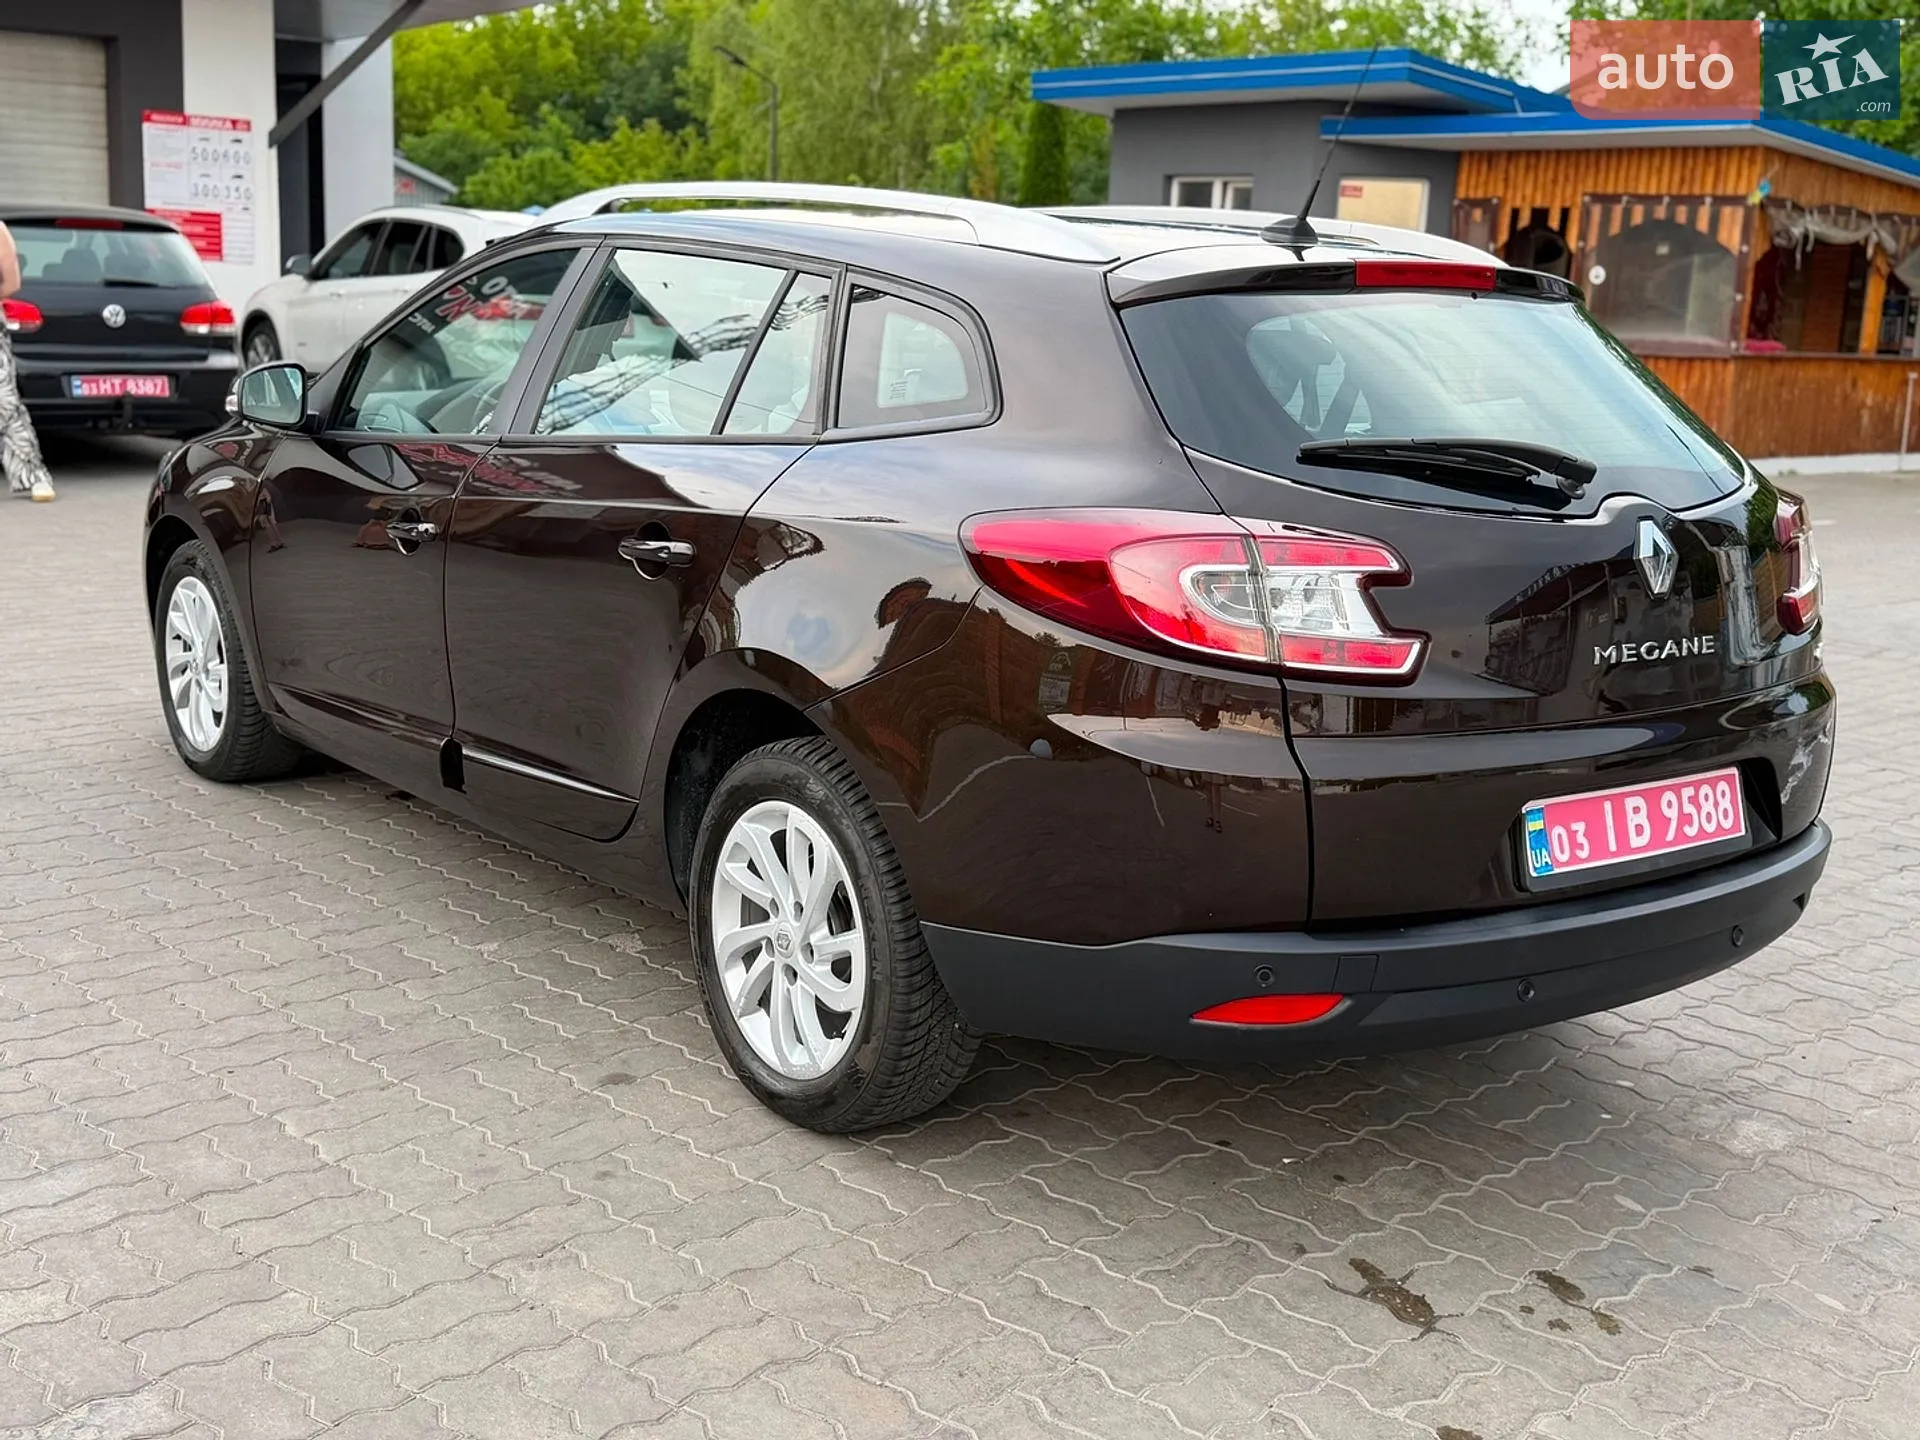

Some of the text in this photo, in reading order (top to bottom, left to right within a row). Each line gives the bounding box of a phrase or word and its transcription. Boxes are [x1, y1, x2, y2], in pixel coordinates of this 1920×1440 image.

[1593, 635, 1715, 665] MEGANE
[1551, 780, 1734, 863] 03 IB 9588
[1532, 848, 1551, 868] UA
